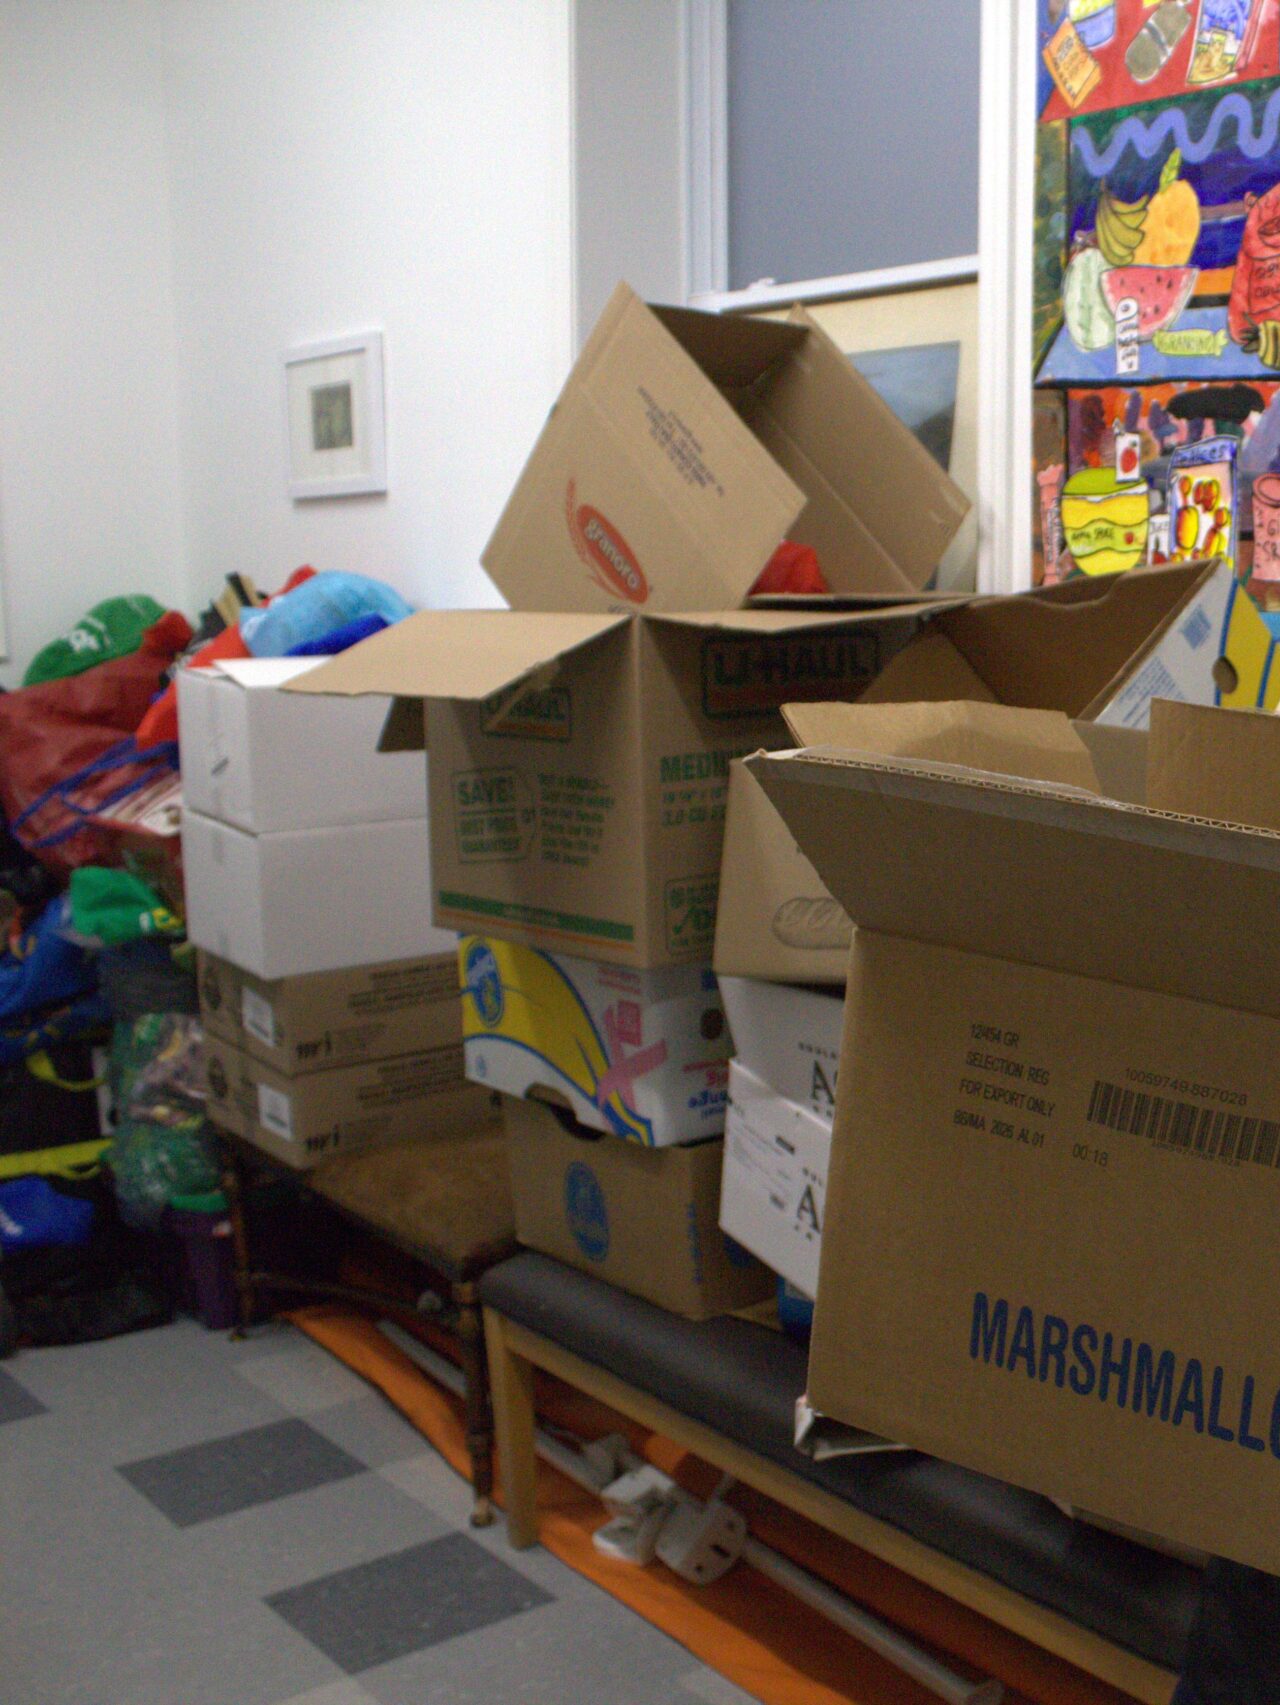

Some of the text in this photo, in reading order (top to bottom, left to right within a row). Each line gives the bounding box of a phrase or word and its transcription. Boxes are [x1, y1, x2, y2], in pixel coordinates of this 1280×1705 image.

[584, 518, 642, 593] granoro
[713, 640, 872, 688] U-HAUL
[966, 1051, 1050, 1085] SELECTION REG
[959, 1078, 1056, 1117] FOR EXPORT ONLY
